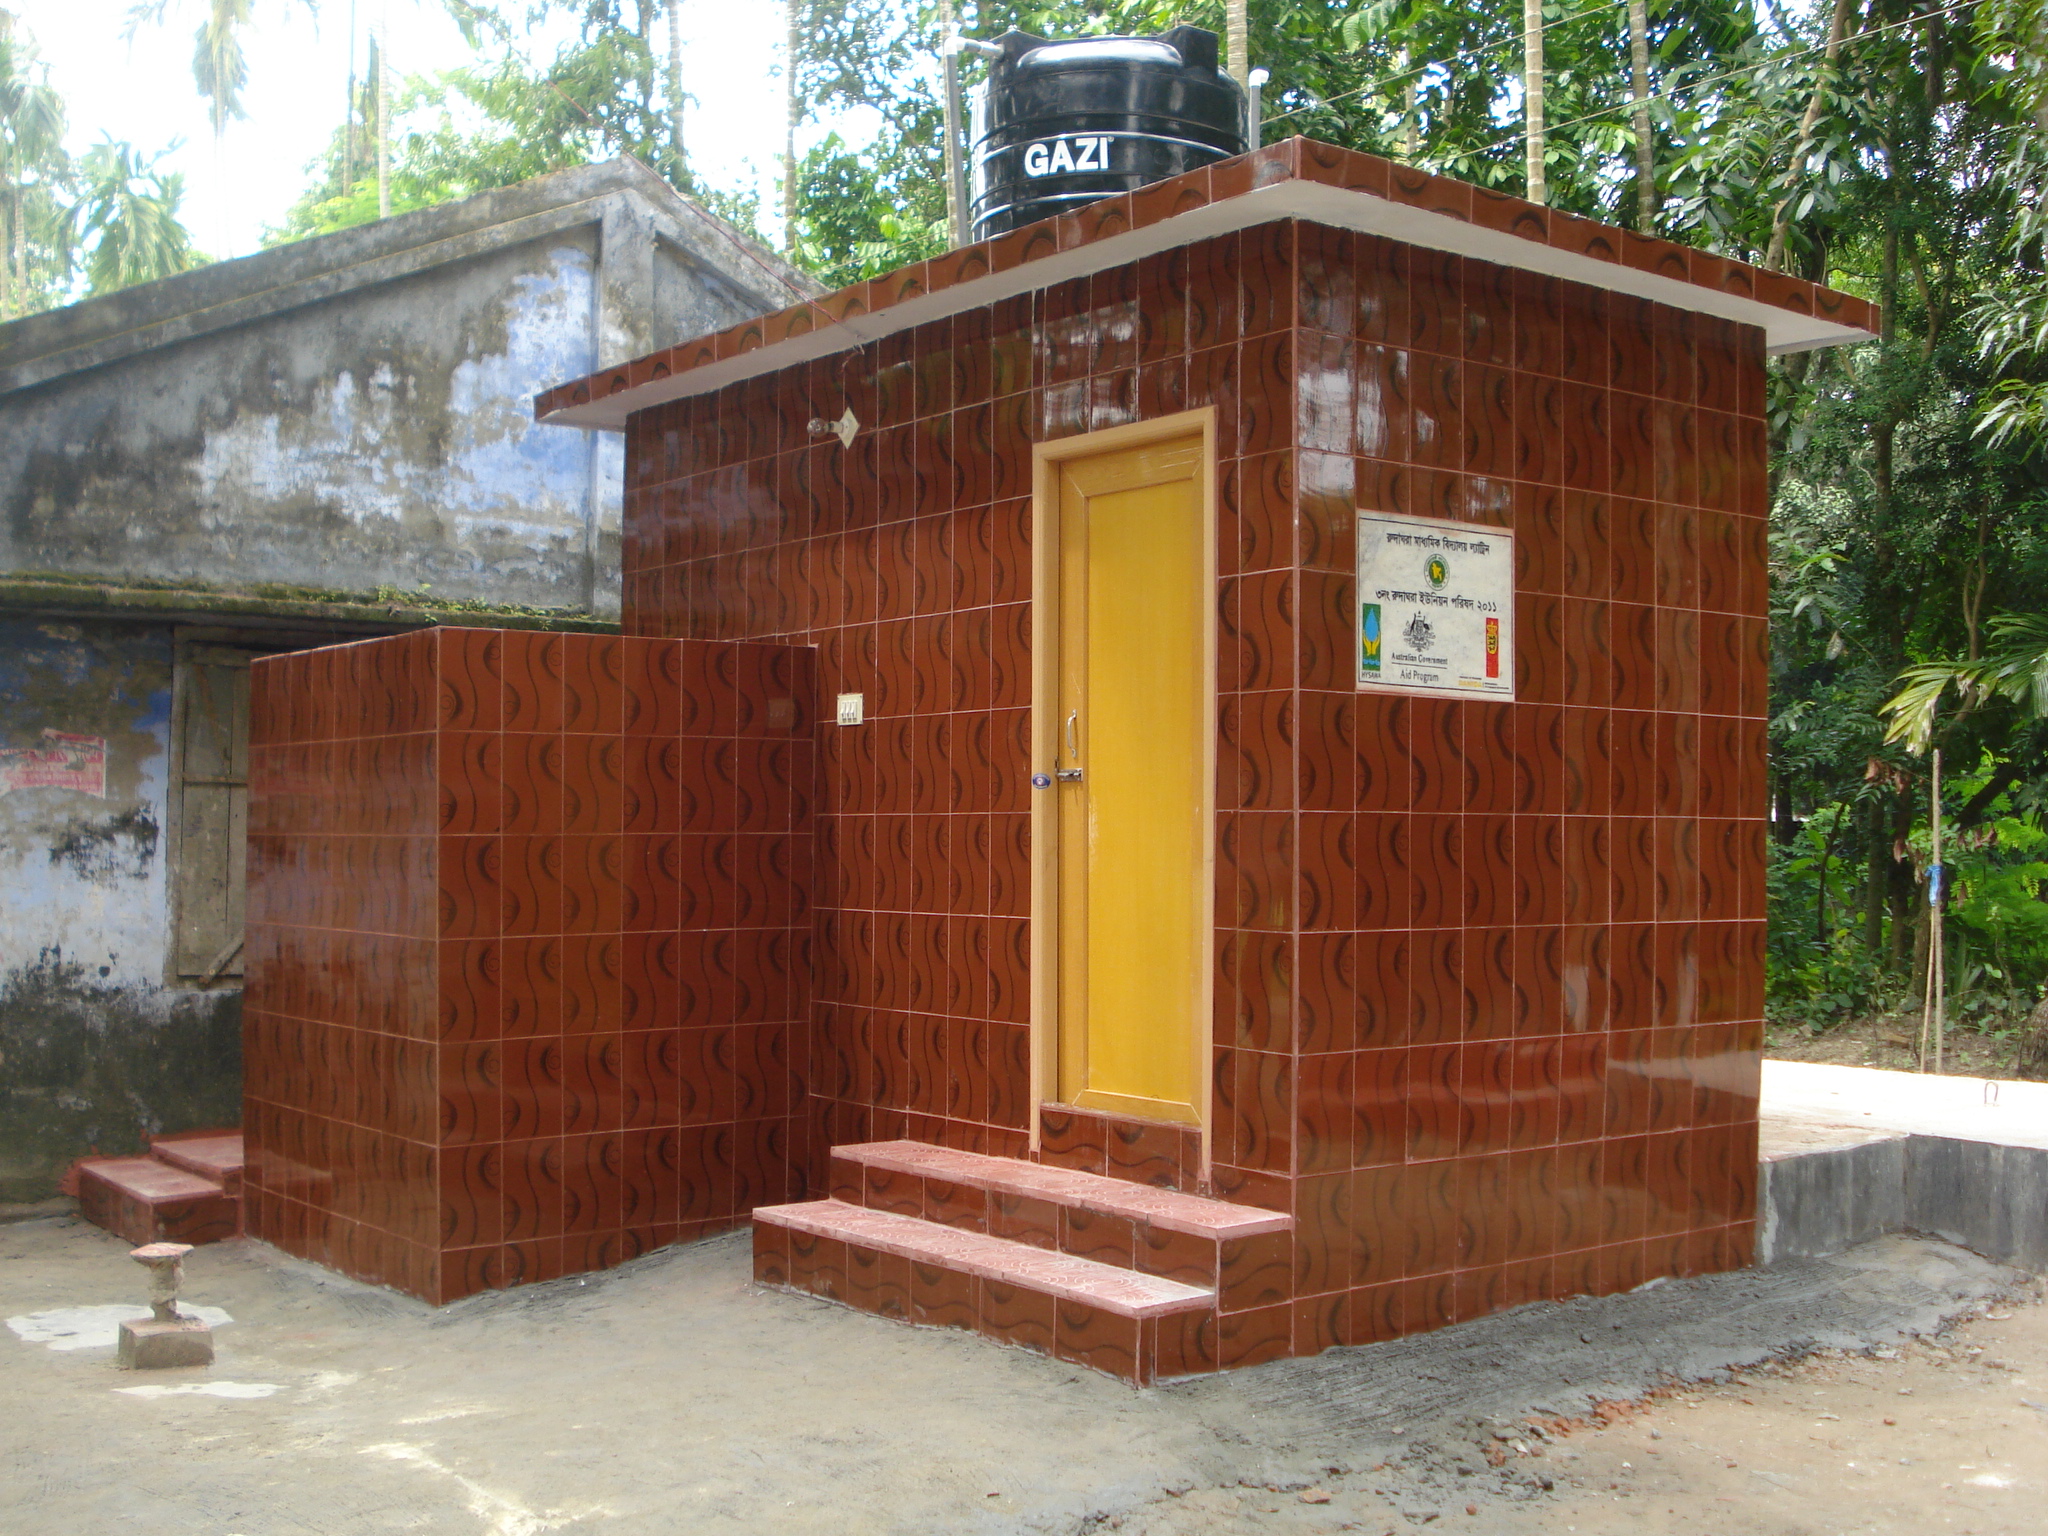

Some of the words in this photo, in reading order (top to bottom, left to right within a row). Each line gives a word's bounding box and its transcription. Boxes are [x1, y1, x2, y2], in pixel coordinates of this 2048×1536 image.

[1024, 136, 1109, 178] GAZI
[1419, 592, 1448, 606] ইউনিয়ন
[1451, 595, 1474, 610] পরিষদ
[1477, 601, 1497, 612] ২০১১
[1391, 653, 1417, 661] Australian
[1418, 655, 1448, 665] Government
[1400, 668, 1412, 680] Aid
[1413, 670, 1439, 684] Program
